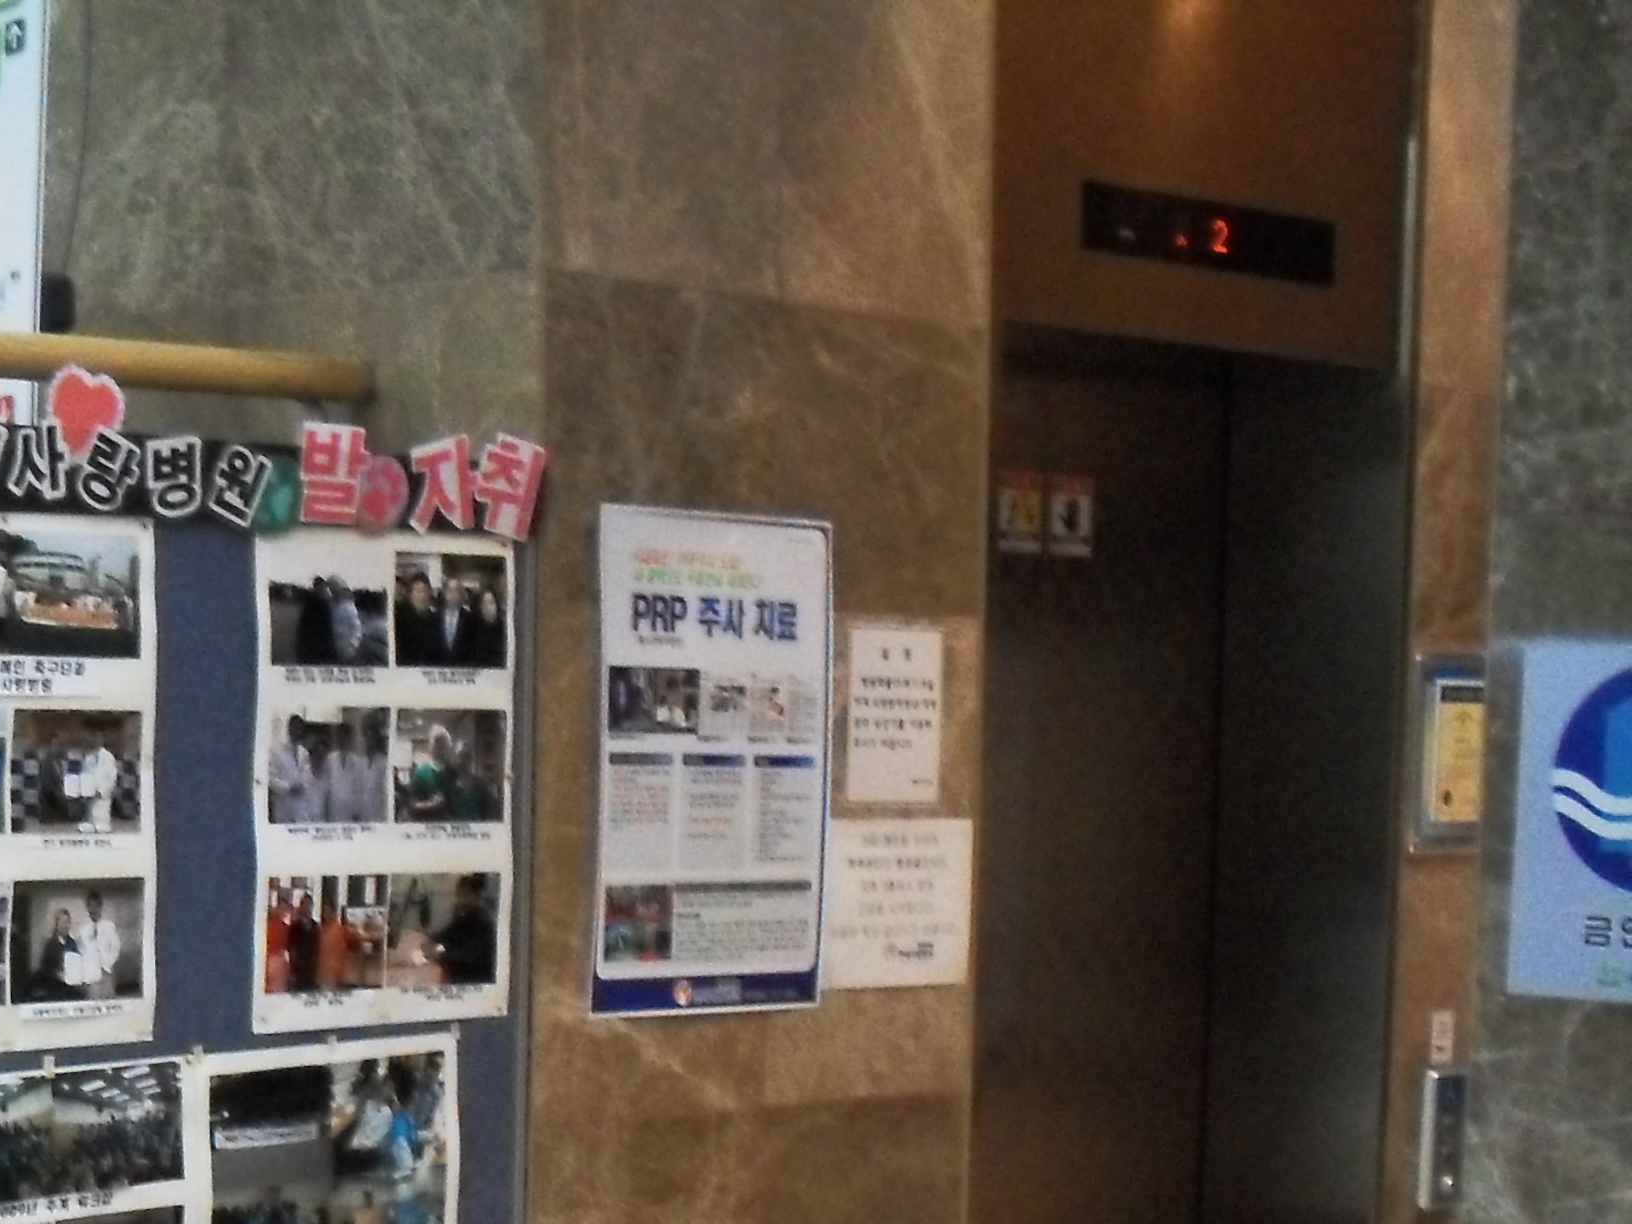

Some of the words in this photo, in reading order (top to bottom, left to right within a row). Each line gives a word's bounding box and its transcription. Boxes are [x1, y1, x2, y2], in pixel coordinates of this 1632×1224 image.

[1213, 220, 1228, 254] 2
[300, 424, 546, 540] 발자취
[632, 591, 687, 634] PRP
[698, 596, 744, 640] 주사
[754, 598, 798, 641] 치료
